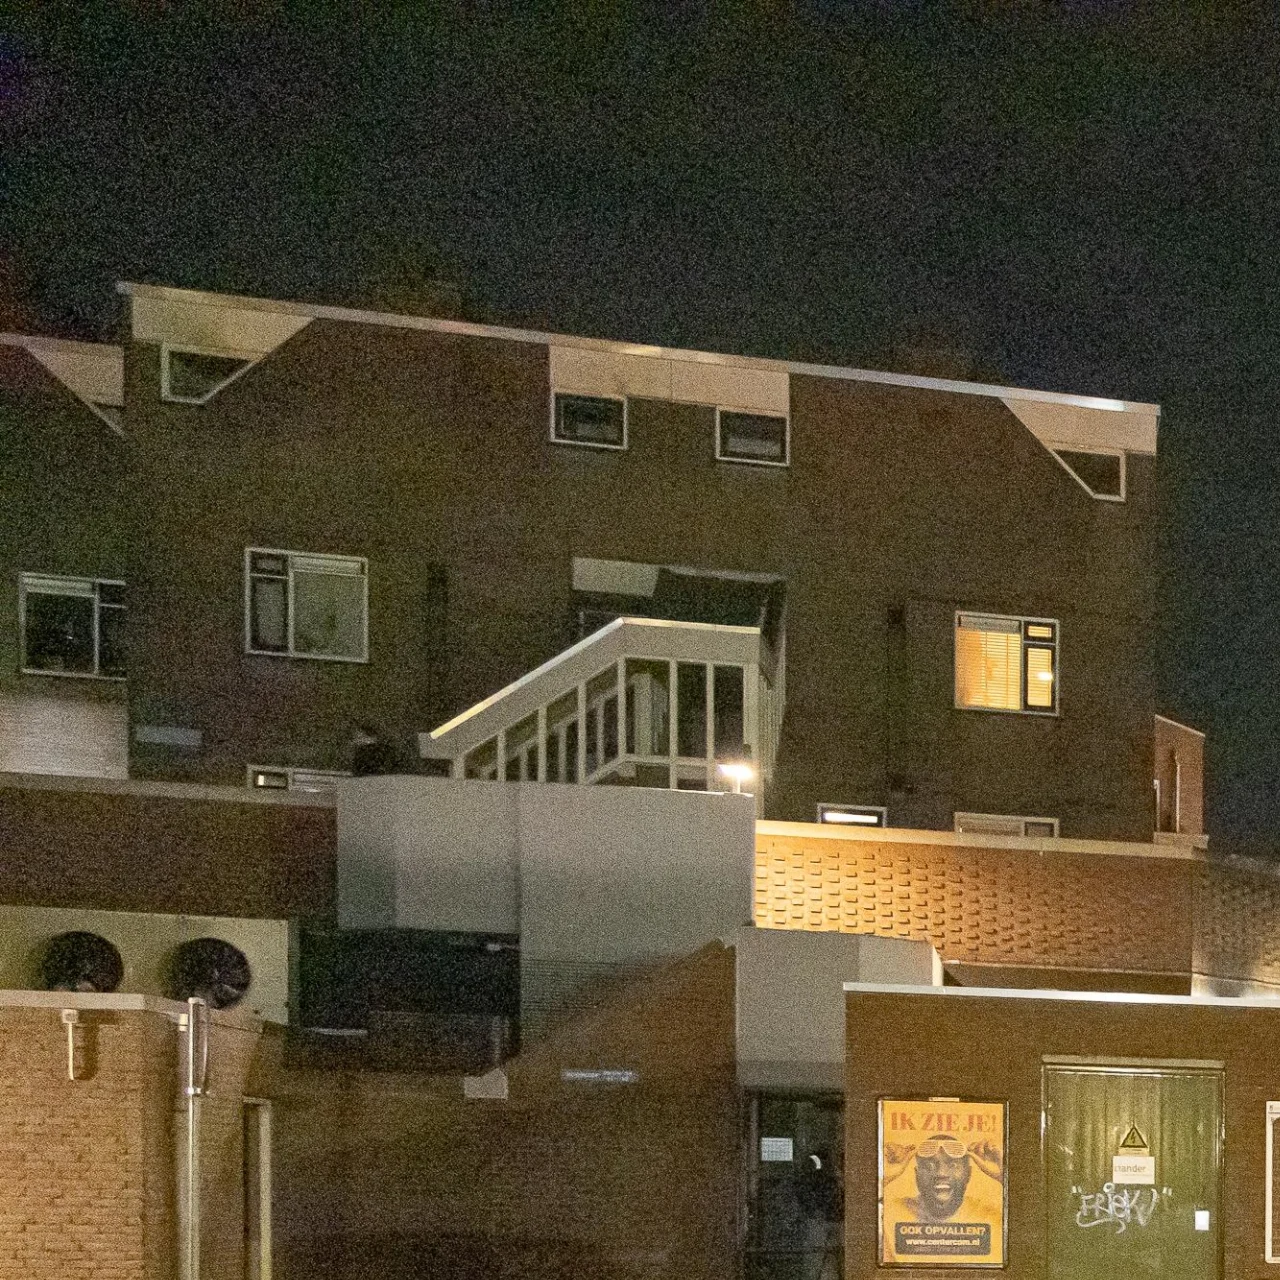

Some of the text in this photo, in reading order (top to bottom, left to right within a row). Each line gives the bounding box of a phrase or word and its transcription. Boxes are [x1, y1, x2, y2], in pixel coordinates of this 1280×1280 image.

[890, 1112, 997, 1133] IK ZIE JE!
[899, 1225, 986, 1236] OOK OPVALLEN?
